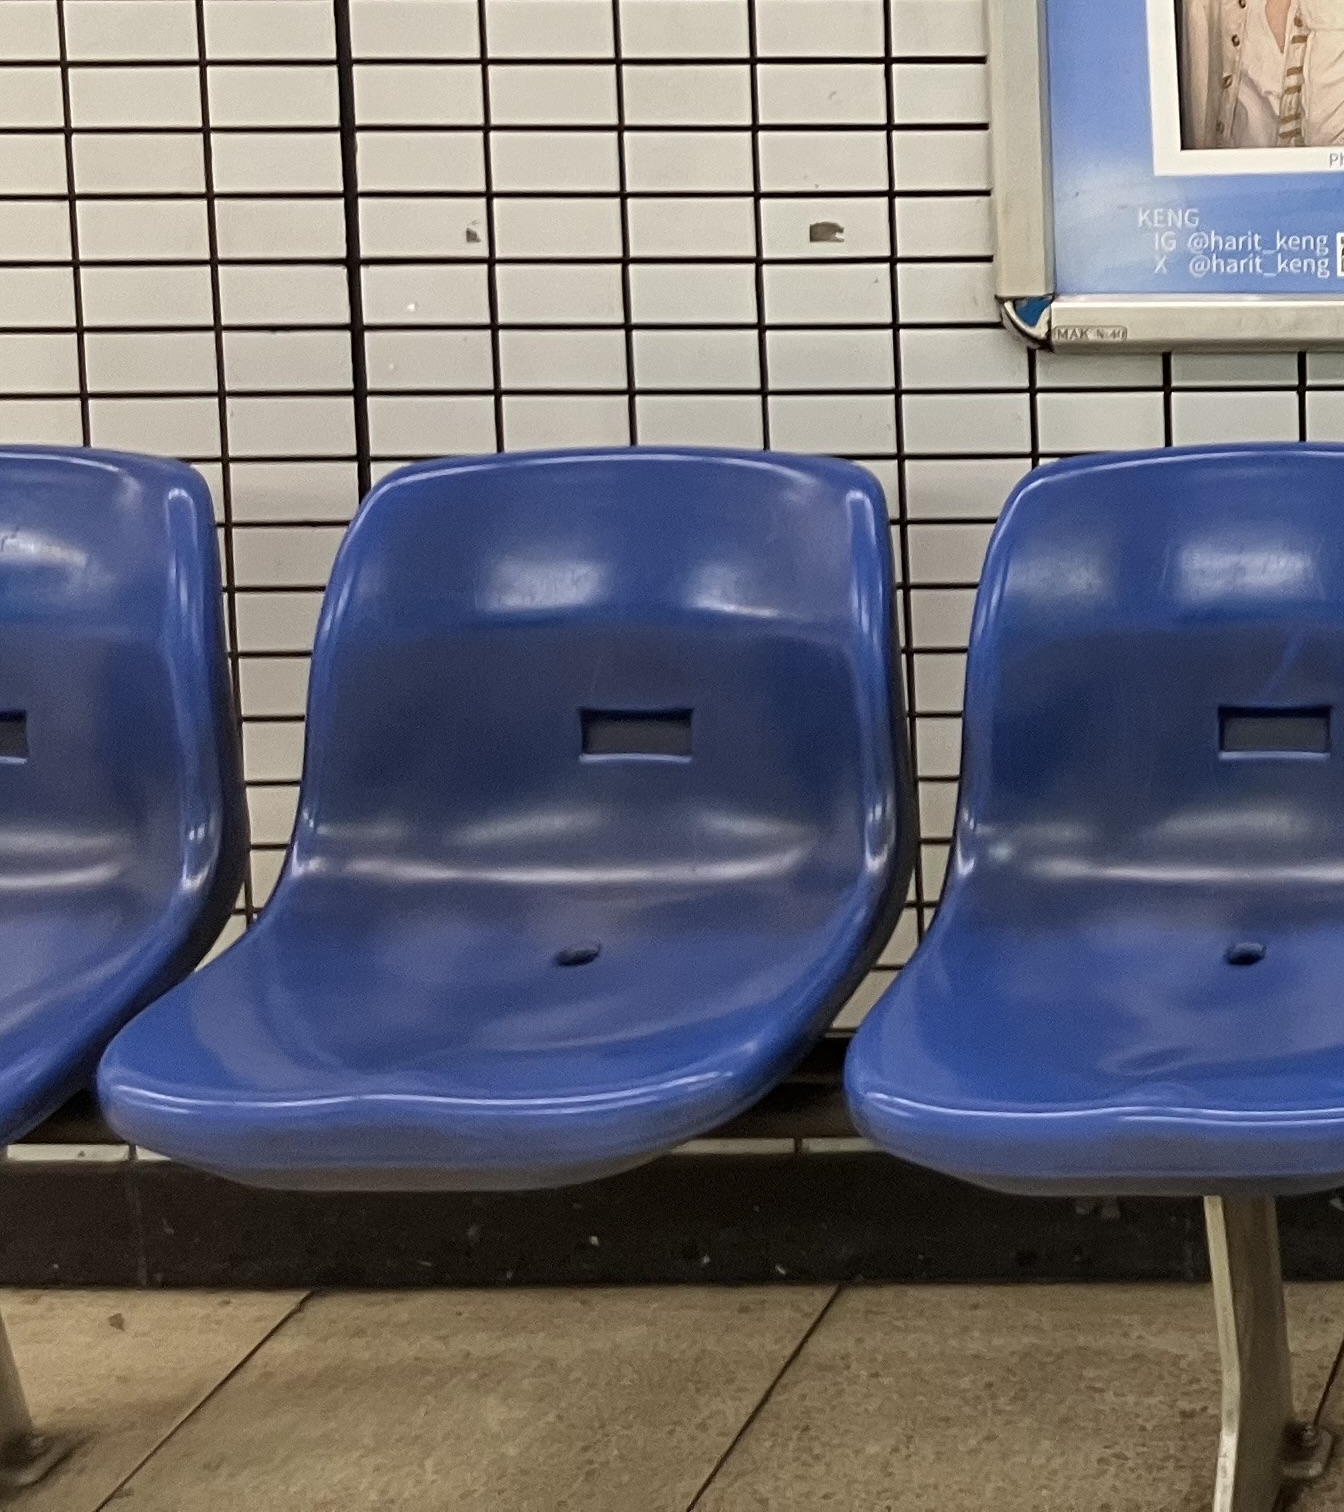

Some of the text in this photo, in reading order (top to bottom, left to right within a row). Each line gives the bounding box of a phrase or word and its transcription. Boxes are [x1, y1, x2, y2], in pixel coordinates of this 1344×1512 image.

[1137, 208, 1200, 227] KENG
[1155, 230, 1329, 257] IG @harit_keng
[1155, 252, 1330, 279] X @harit_keng
